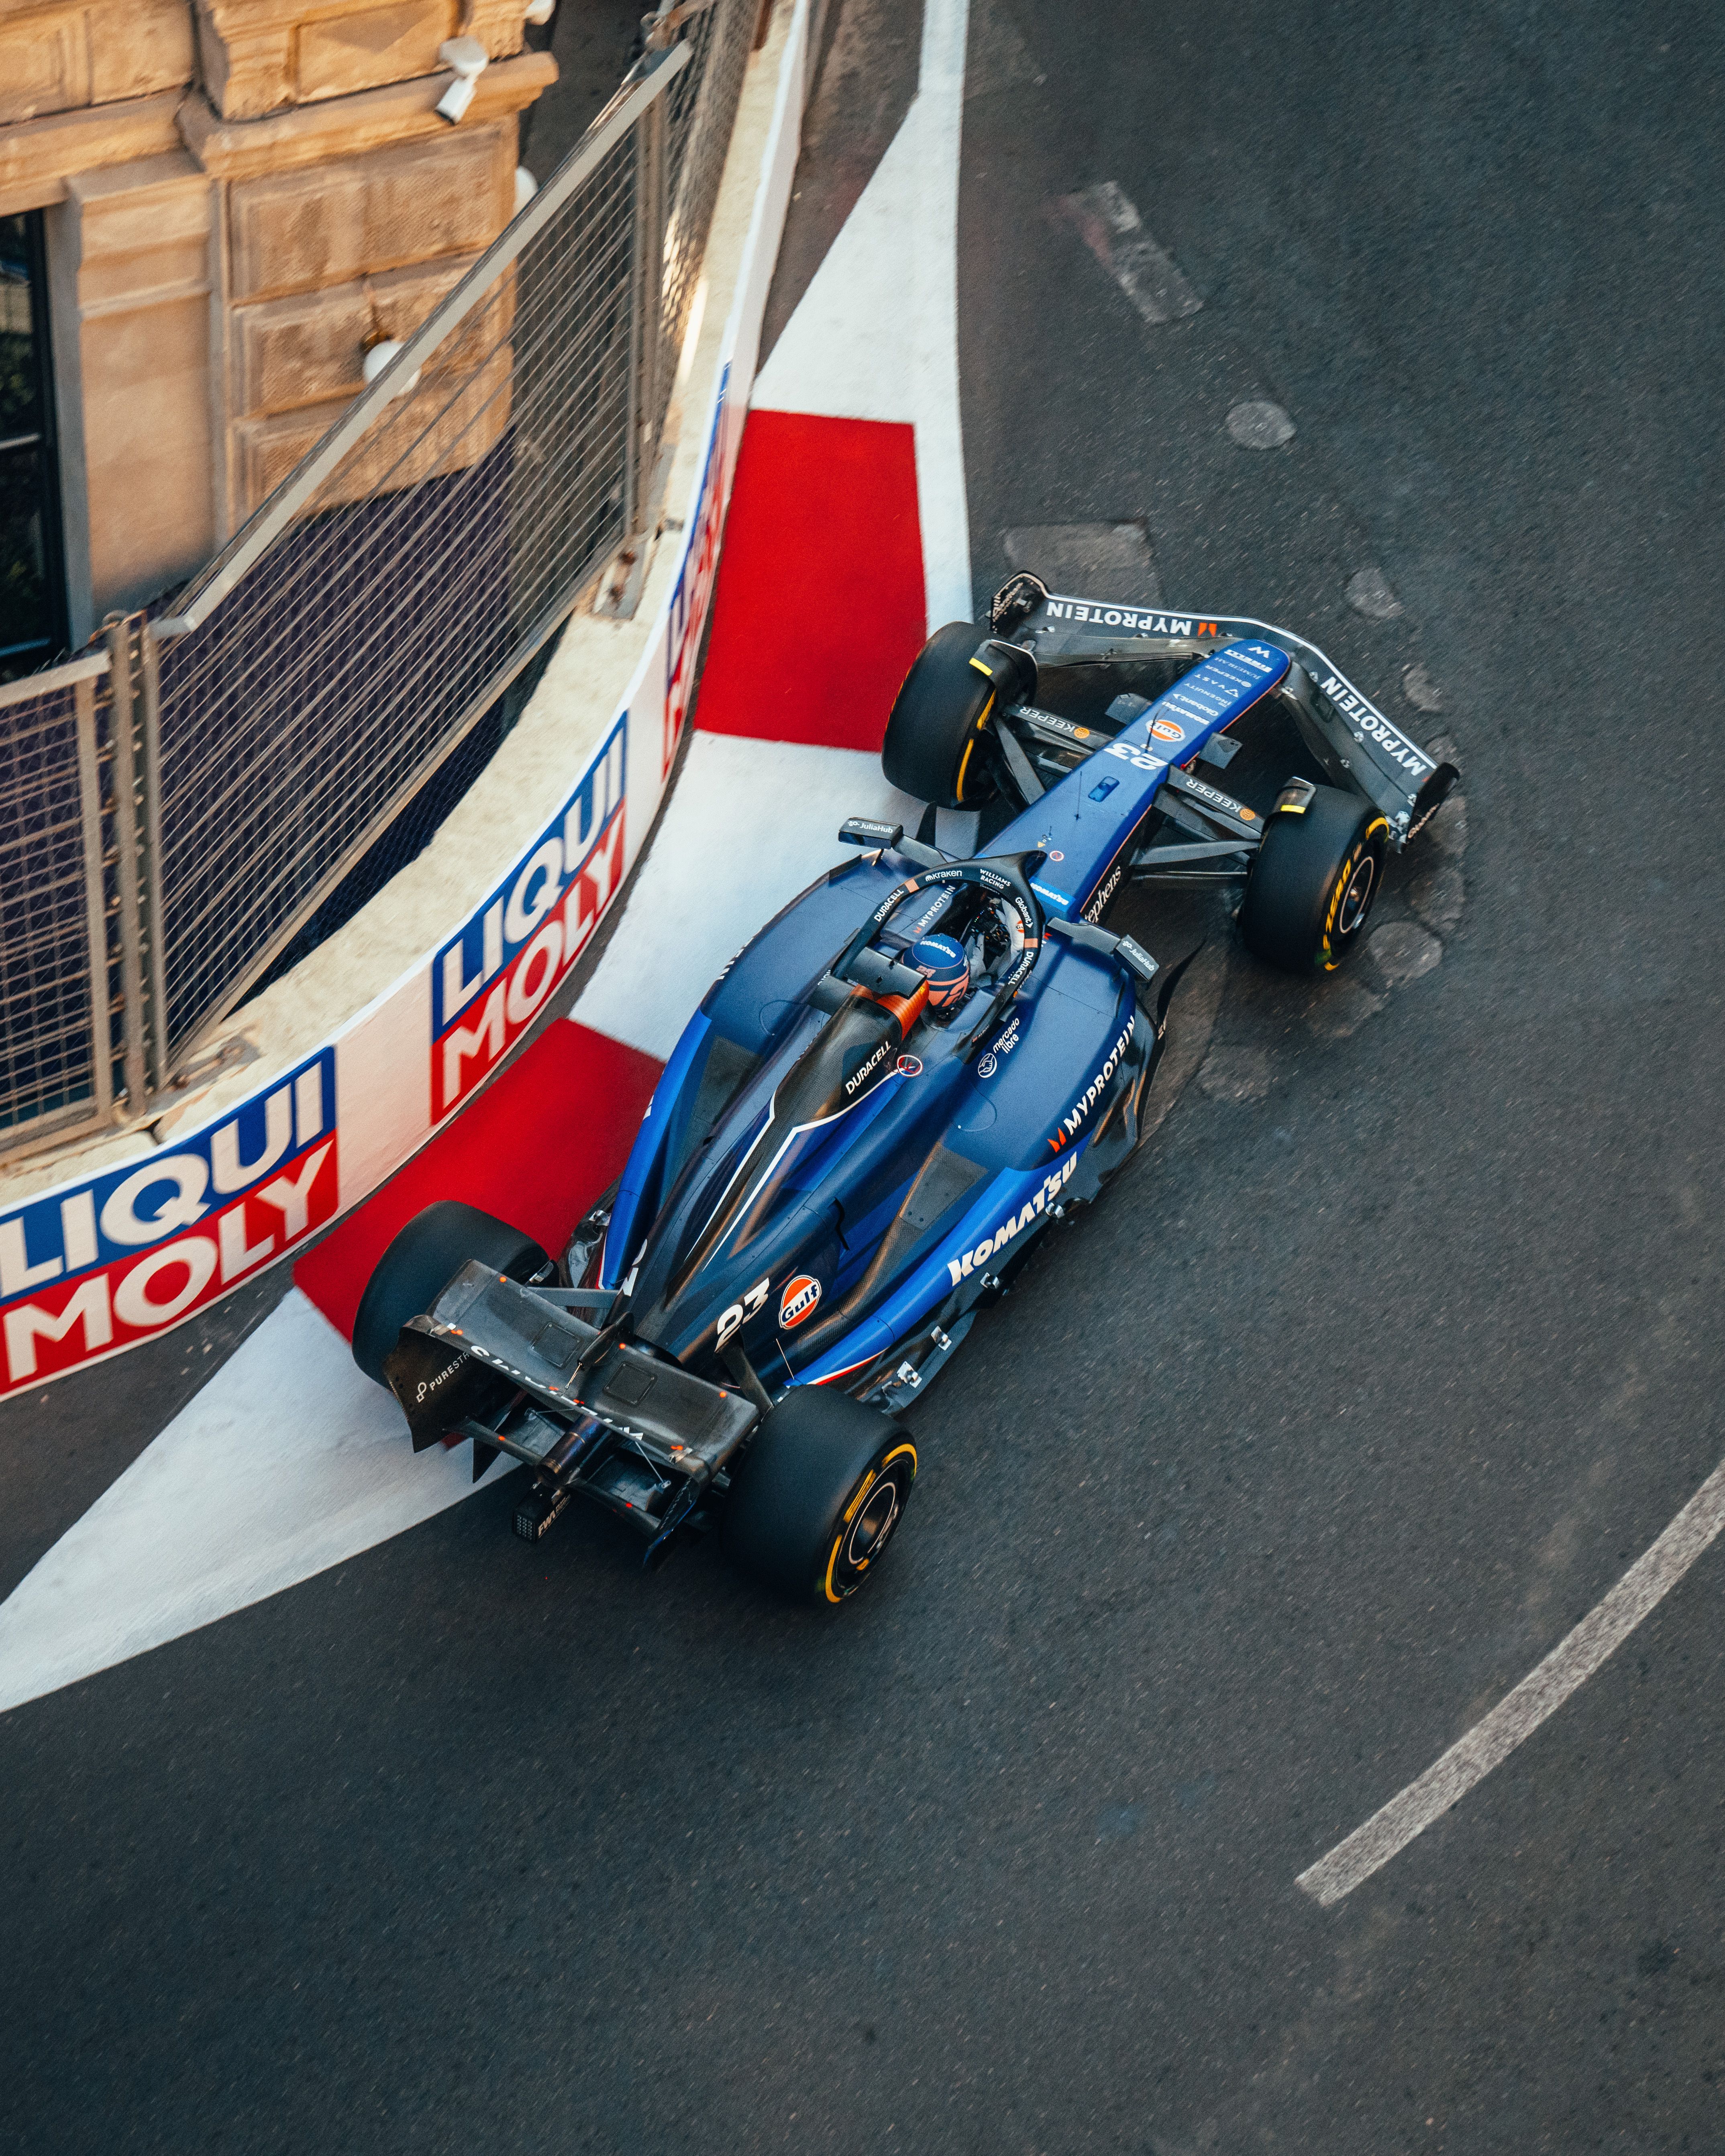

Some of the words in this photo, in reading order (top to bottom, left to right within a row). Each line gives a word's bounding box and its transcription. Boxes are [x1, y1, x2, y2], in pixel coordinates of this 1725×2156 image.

[1046, 602, 1192, 636] MYPROTEIN
[1205, 665, 1242, 683] KEEPER
[1224, 649, 1273, 673] PIRELLI
[1184, 683, 1232, 706] INGENUITY
[1195, 674, 1225, 689] VAST
[1020, 706, 1075, 732] KEEPER
[1162, 701, 1210, 725] KOMATSU
[1320, 677, 1427, 776] MYPROTEIN
[1150, 722, 1181, 738] Gulf
[1104, 743, 1169, 770] 23
[1186, 778, 1242, 813] KEEPER
[859, 823, 893, 833] JuliaHub
[442, 727, 623, 1025] LIQUI
[932, 870, 962, 880] kraken
[980, 869, 1011, 886] WILLIAMS
[980, 875, 1004, 889] RACING
[874, 888, 904, 922] DURACELL
[918, 885, 956, 927] MYPROTEIN
[1030, 882, 1069, 905] KOMATSU
[1015, 897, 1032, 924] Globant
[442, 806, 625, 1111] MOLY
[920, 941, 956, 958] KOMATSU
[1128, 948, 1155, 972] JuliaHub
[1008, 951, 1034, 985] DURACELL
[993, 1018, 1020, 1054] mercado
[1001, 1033, 1019, 1054] libre
[845, 1041, 891, 1095] DURACELL
[1063, 1015, 1135, 1136] MYPROTEIN
[0, 1061, 323, 1298] LIQUI
[947, 1151, 1077, 1287] KOMATSU
[3, 1138, 335, 1383] MOLY
[714, 1278, 770, 1353] 23
[781, 1284, 818, 1324] Gulf
[429, 1351, 469, 1391] PURESTR
